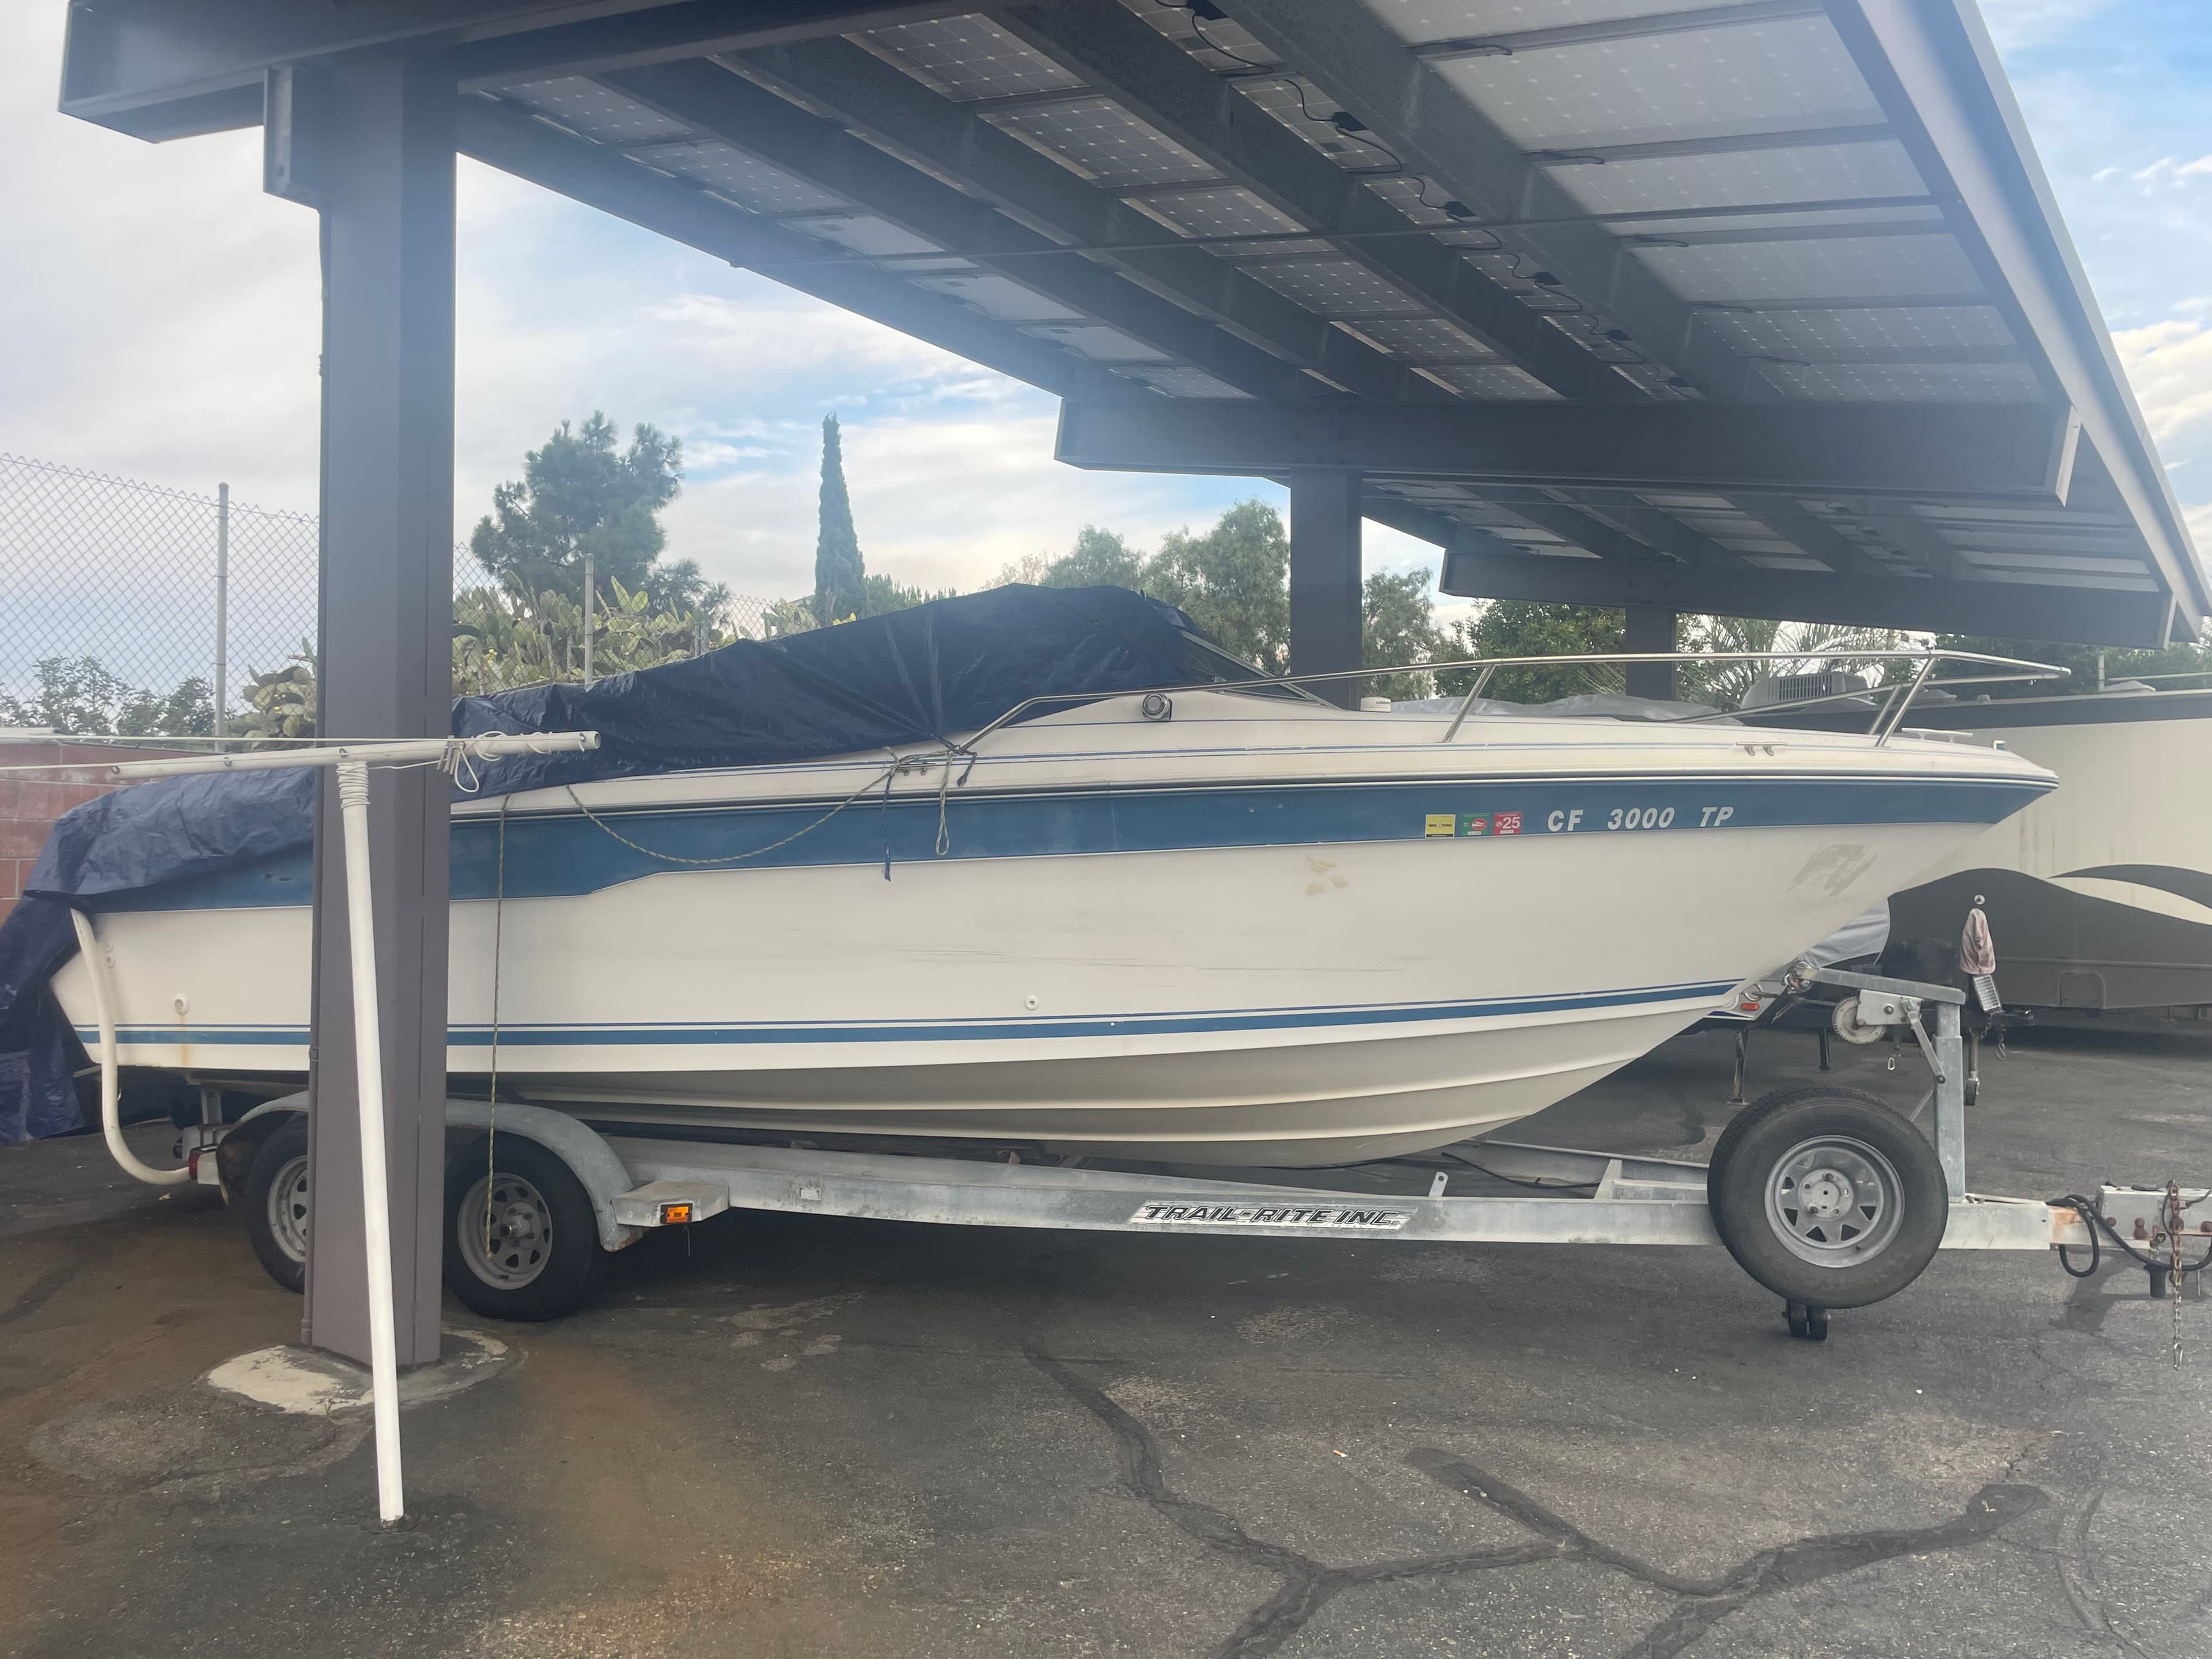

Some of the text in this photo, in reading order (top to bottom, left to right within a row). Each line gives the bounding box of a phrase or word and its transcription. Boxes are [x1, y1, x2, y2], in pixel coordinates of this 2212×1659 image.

[1502, 817, 1520, 829] 25
[1548, 806, 1733, 832] CF 3000 TP
[1145, 1205, 1400, 1225] TRAIL-RITE INC.
